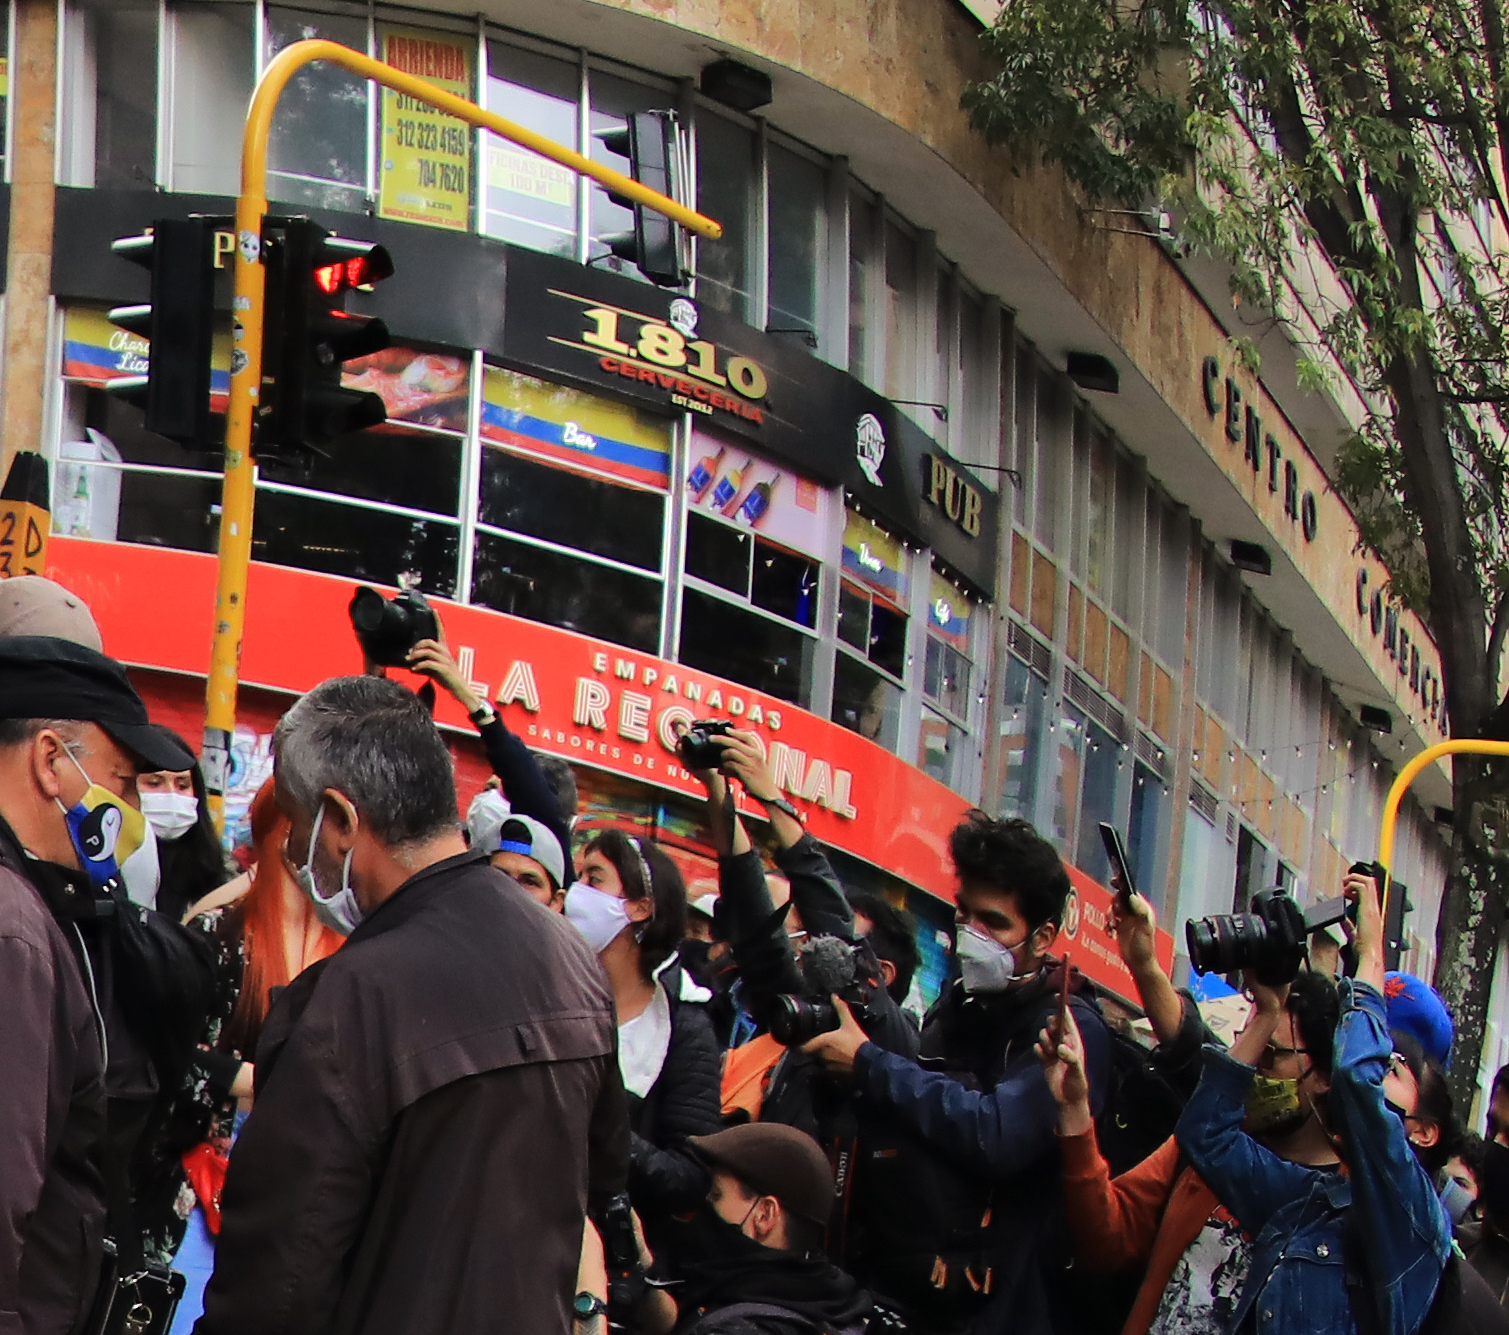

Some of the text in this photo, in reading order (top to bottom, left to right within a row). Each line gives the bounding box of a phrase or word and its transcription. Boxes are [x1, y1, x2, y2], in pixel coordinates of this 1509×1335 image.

[397, 118, 415, 147] 312
[417, 123, 437, 152] 323
[440, 163, 465, 193] 7620
[582, 308, 769, 400] 1.810
[599, 356, 765, 425] CERVECERIA
[563, 421, 598, 451] Bar
[1202, 354, 1319, 544] CENTRO
[927, 453, 982, 538] PUB
[592, 652, 783, 731] EMPANADAS
[457, 646, 858, 820] LA REGNAL
[526, 724, 656, 769] SABORES DE
